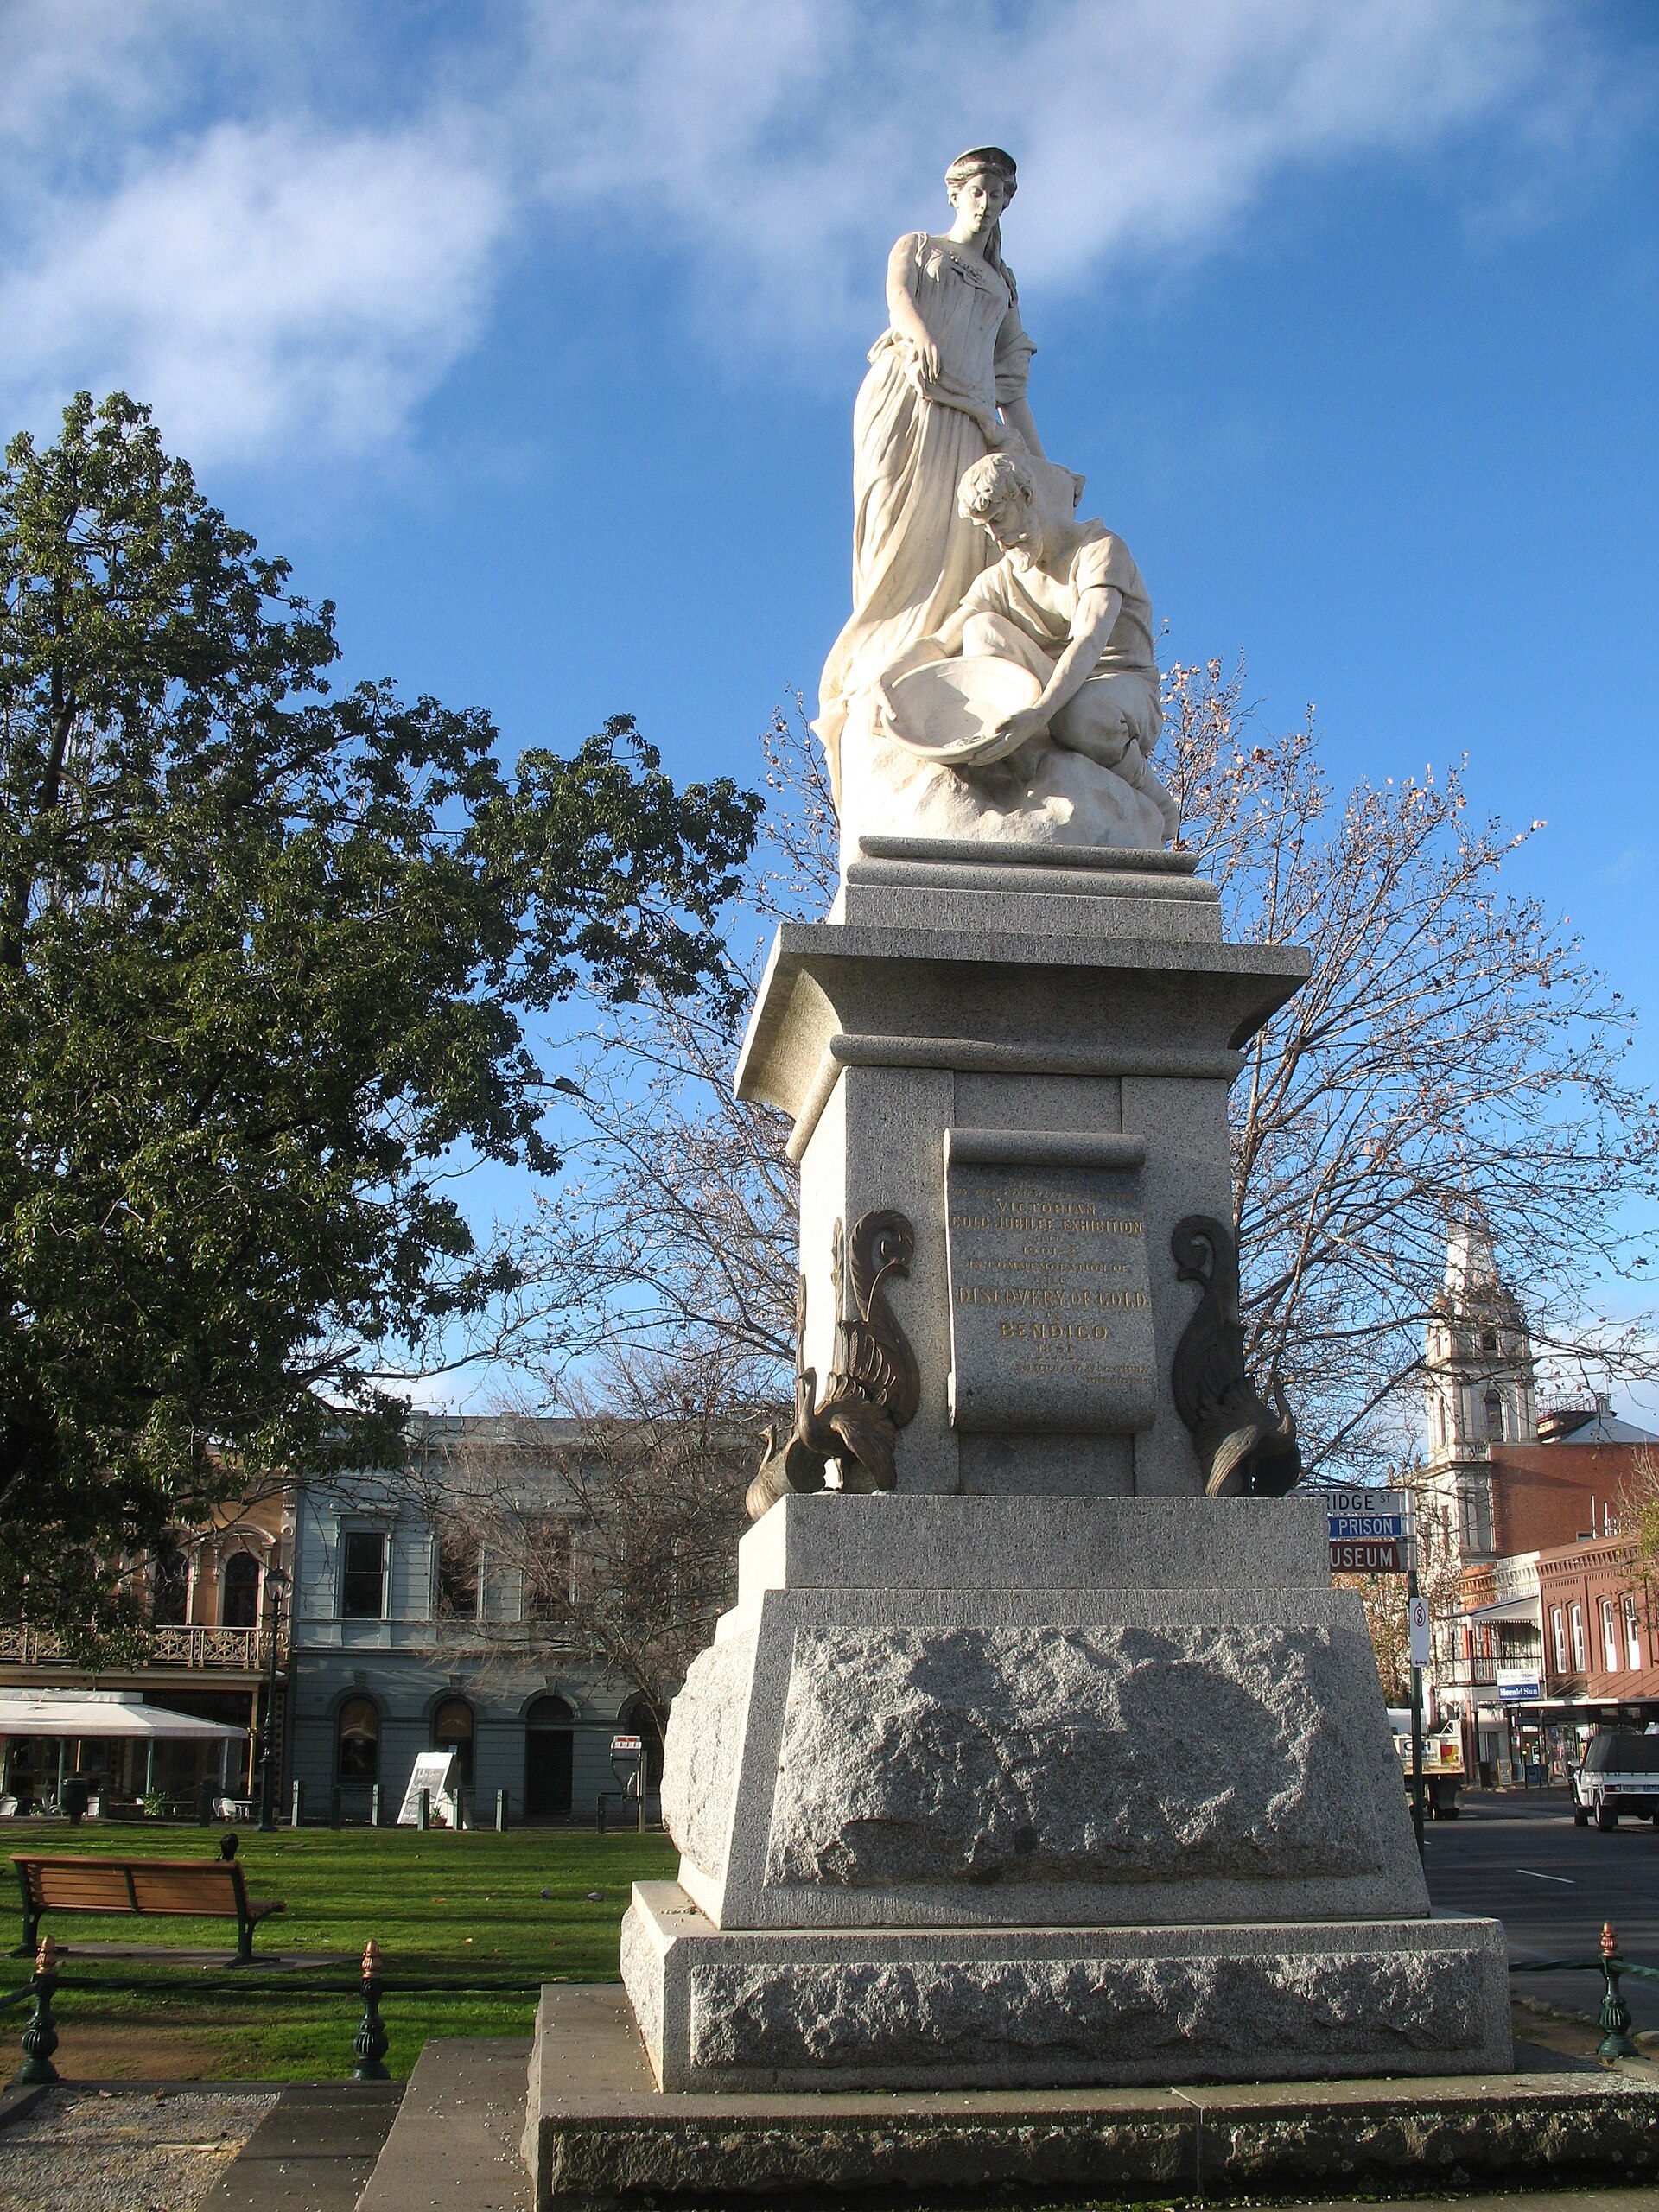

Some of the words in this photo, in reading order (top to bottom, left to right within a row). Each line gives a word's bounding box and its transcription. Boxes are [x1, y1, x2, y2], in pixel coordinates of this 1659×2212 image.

[996, 1201, 1096, 1216] VICTORIAN
[951, 1215, 990, 1230] GOLD
[995, 1216, 1057, 1233] JUBILEE
[1062, 1218, 1143, 1236] EXHIBITION
[988, 1261, 1107, 1274] COMMEMORATION
[957, 1286, 1066, 1306] DISCOVERY
[1071, 1290, 1093, 1307] OF
[1097, 1291, 1147, 1309] GOLD
[999, 1322, 1109, 1340] BENDIGO
[1306, 1494, 1375, 1510] RIDGE
[1338, 1518, 1393, 1535] PRISON
[1330, 1548, 1393, 1567] USEUM
[1499, 1688, 1523, 1696] Herald
[1523, 1687, 1538, 1695] Sun
